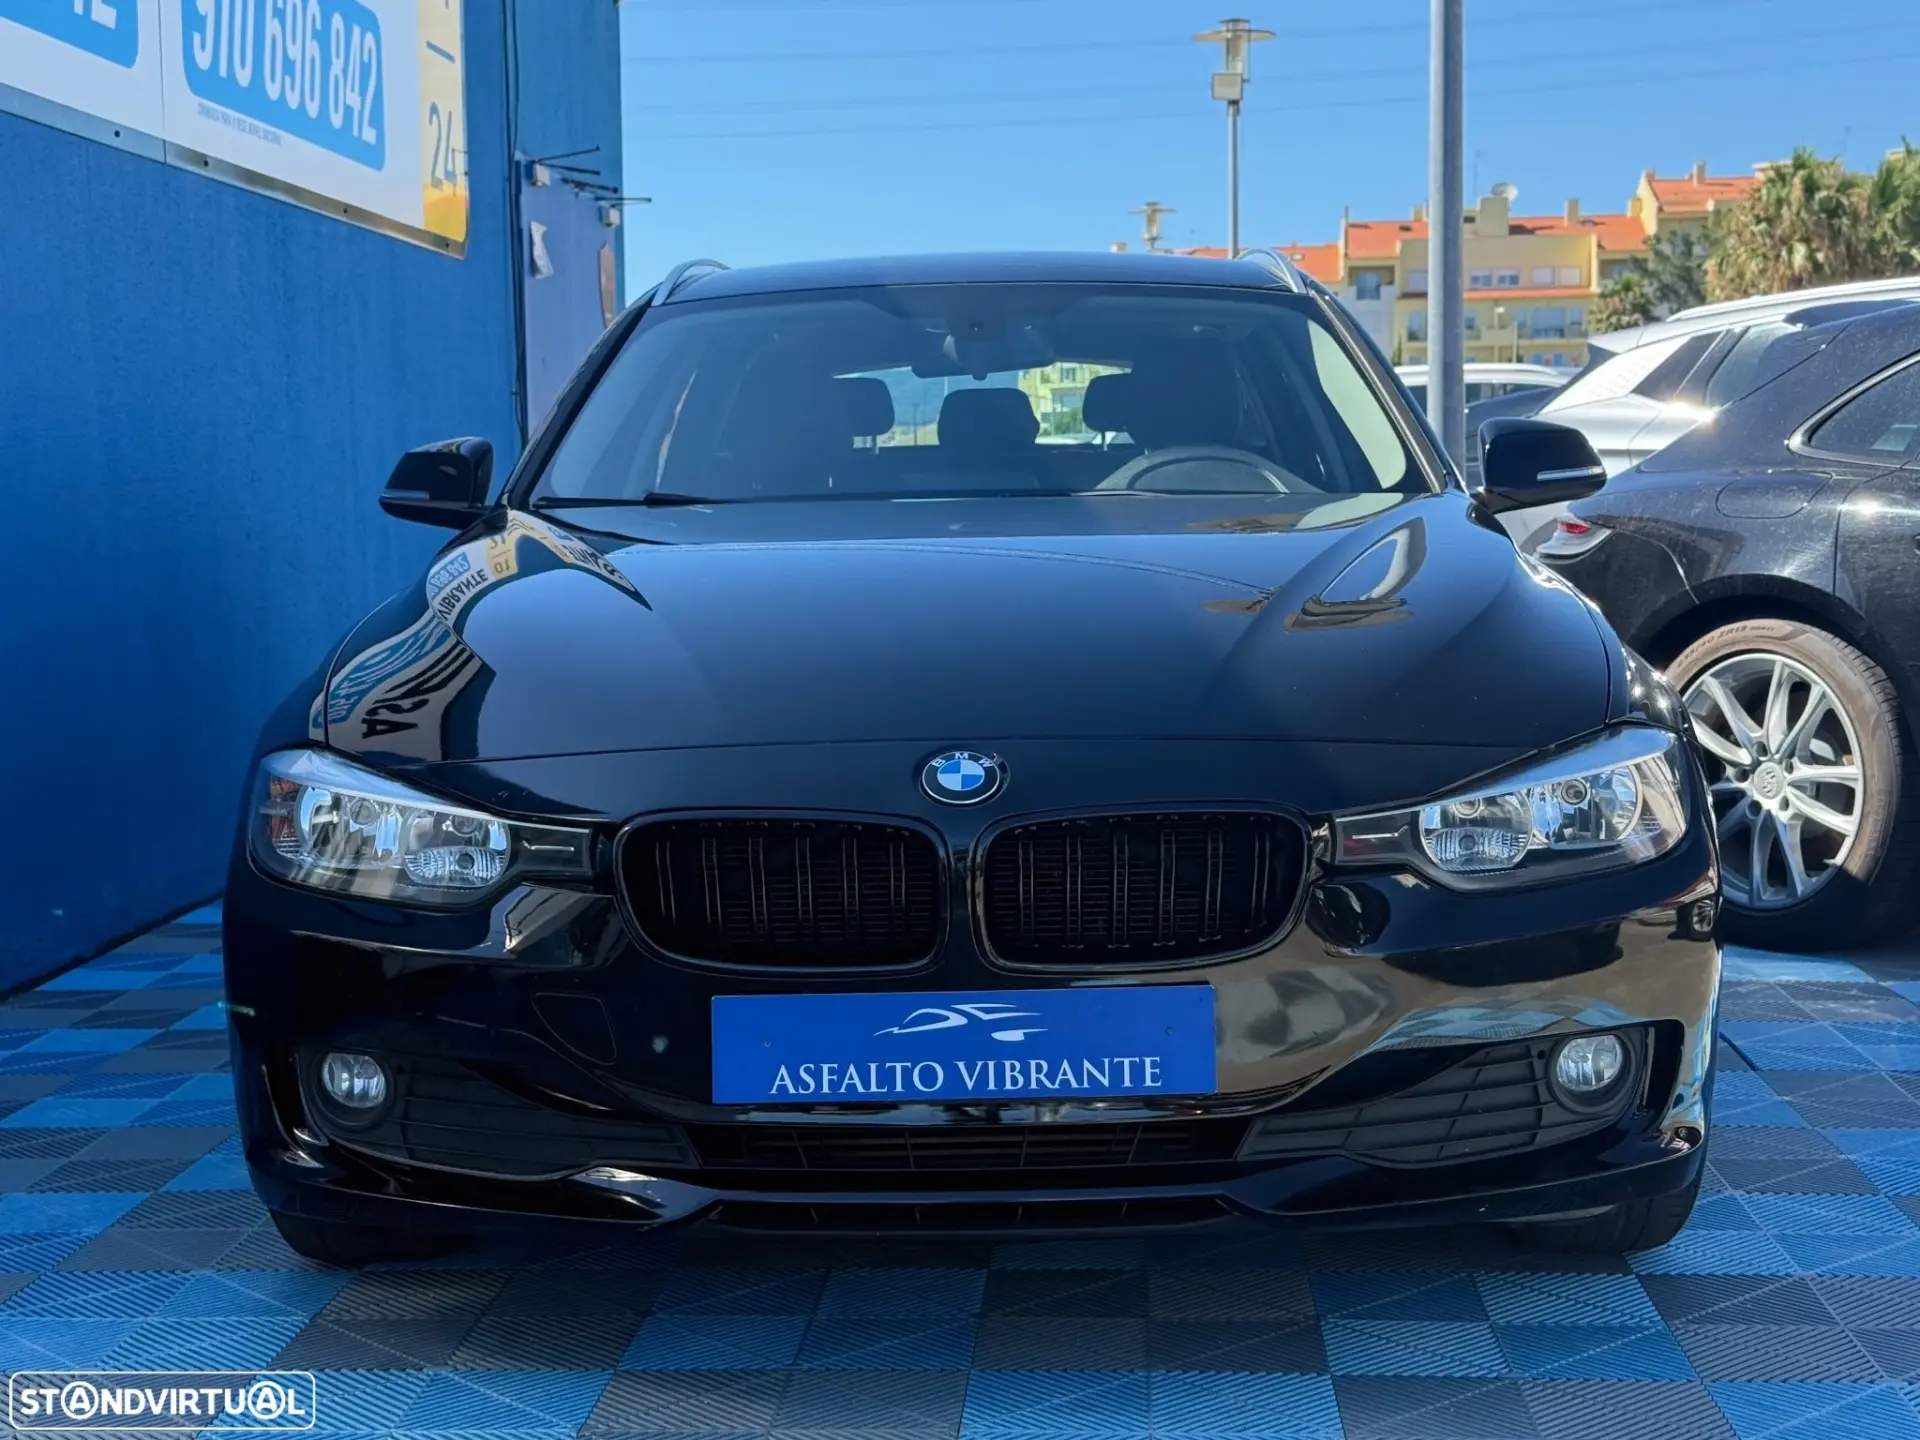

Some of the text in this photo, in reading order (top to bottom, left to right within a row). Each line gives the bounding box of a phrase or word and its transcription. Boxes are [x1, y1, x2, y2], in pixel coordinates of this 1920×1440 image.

[264, 0, 322, 120] 696
[328, 12, 377, 145] 842
[429, 102, 457, 198] 24
[931, 752, 994, 768] BMW
[769, 1056, 1163, 1094] ASFALTO VIBRANTE
